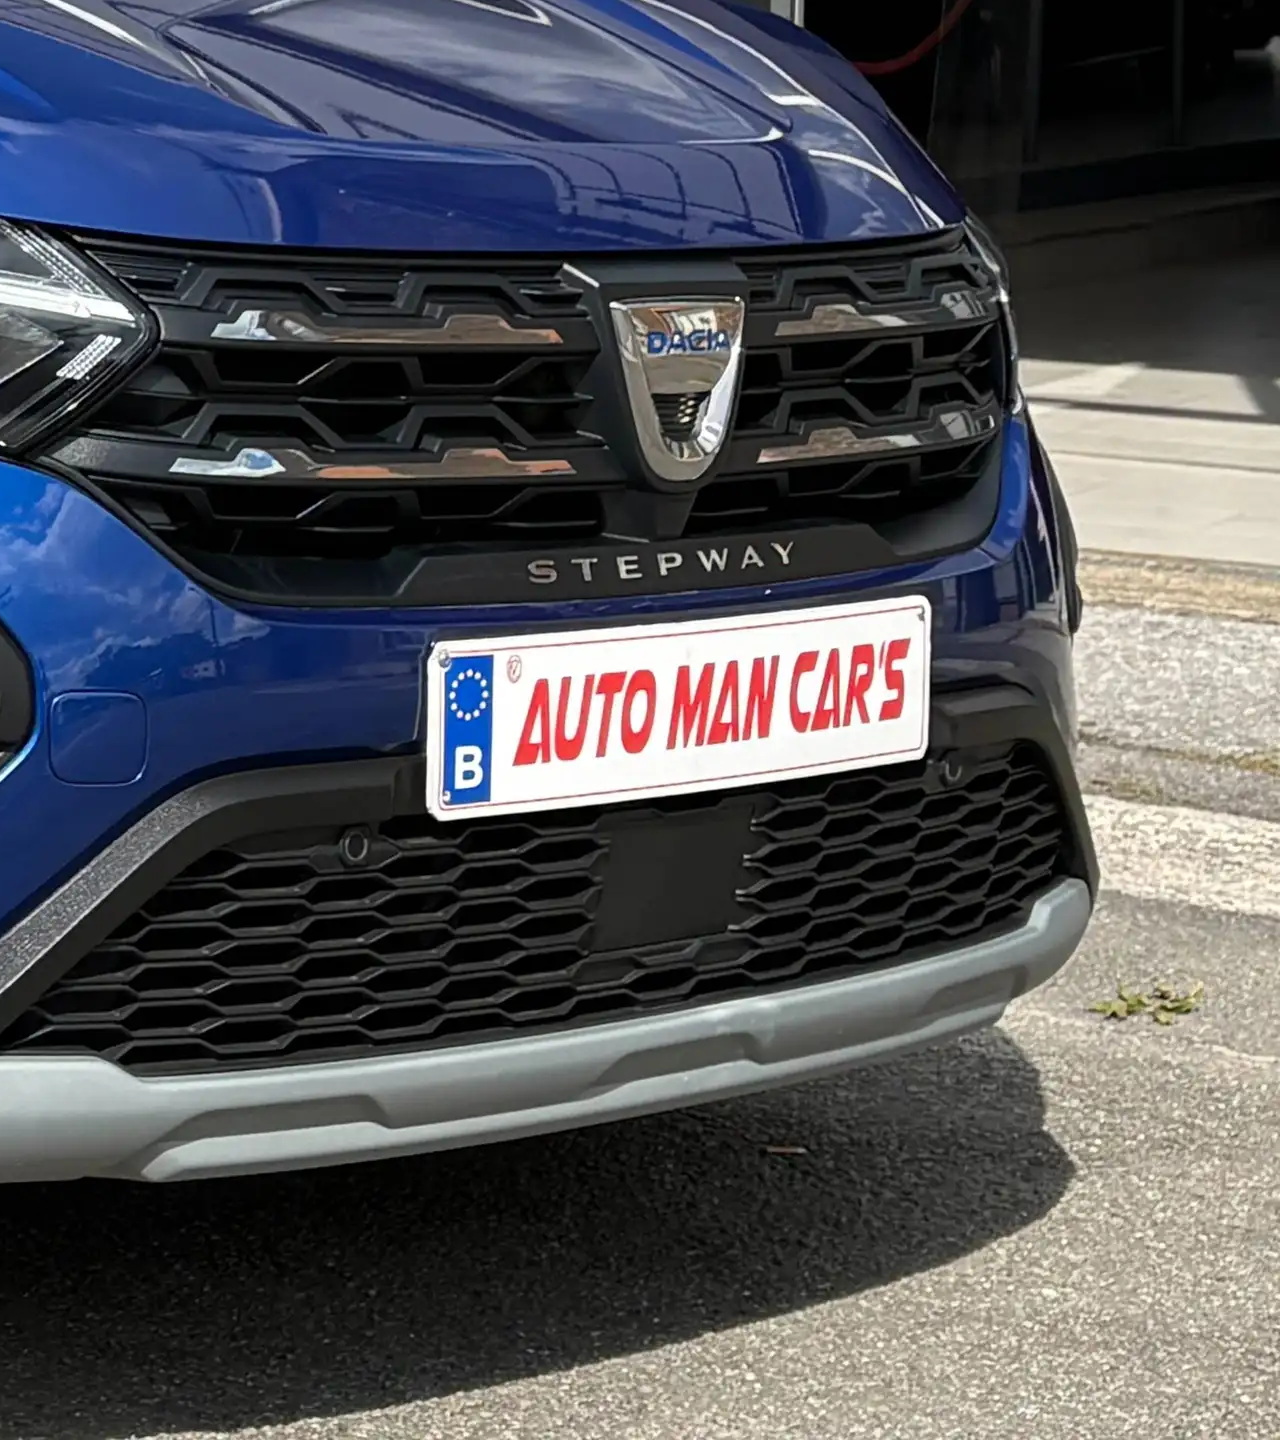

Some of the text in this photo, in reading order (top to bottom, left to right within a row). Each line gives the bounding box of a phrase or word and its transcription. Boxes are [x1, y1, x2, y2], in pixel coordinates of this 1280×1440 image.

[647, 329, 730, 354] DACIA
[527, 541, 795, 584] STEPWAY
[453, 637, 912, 791] B AUTO MAN CAR'S
